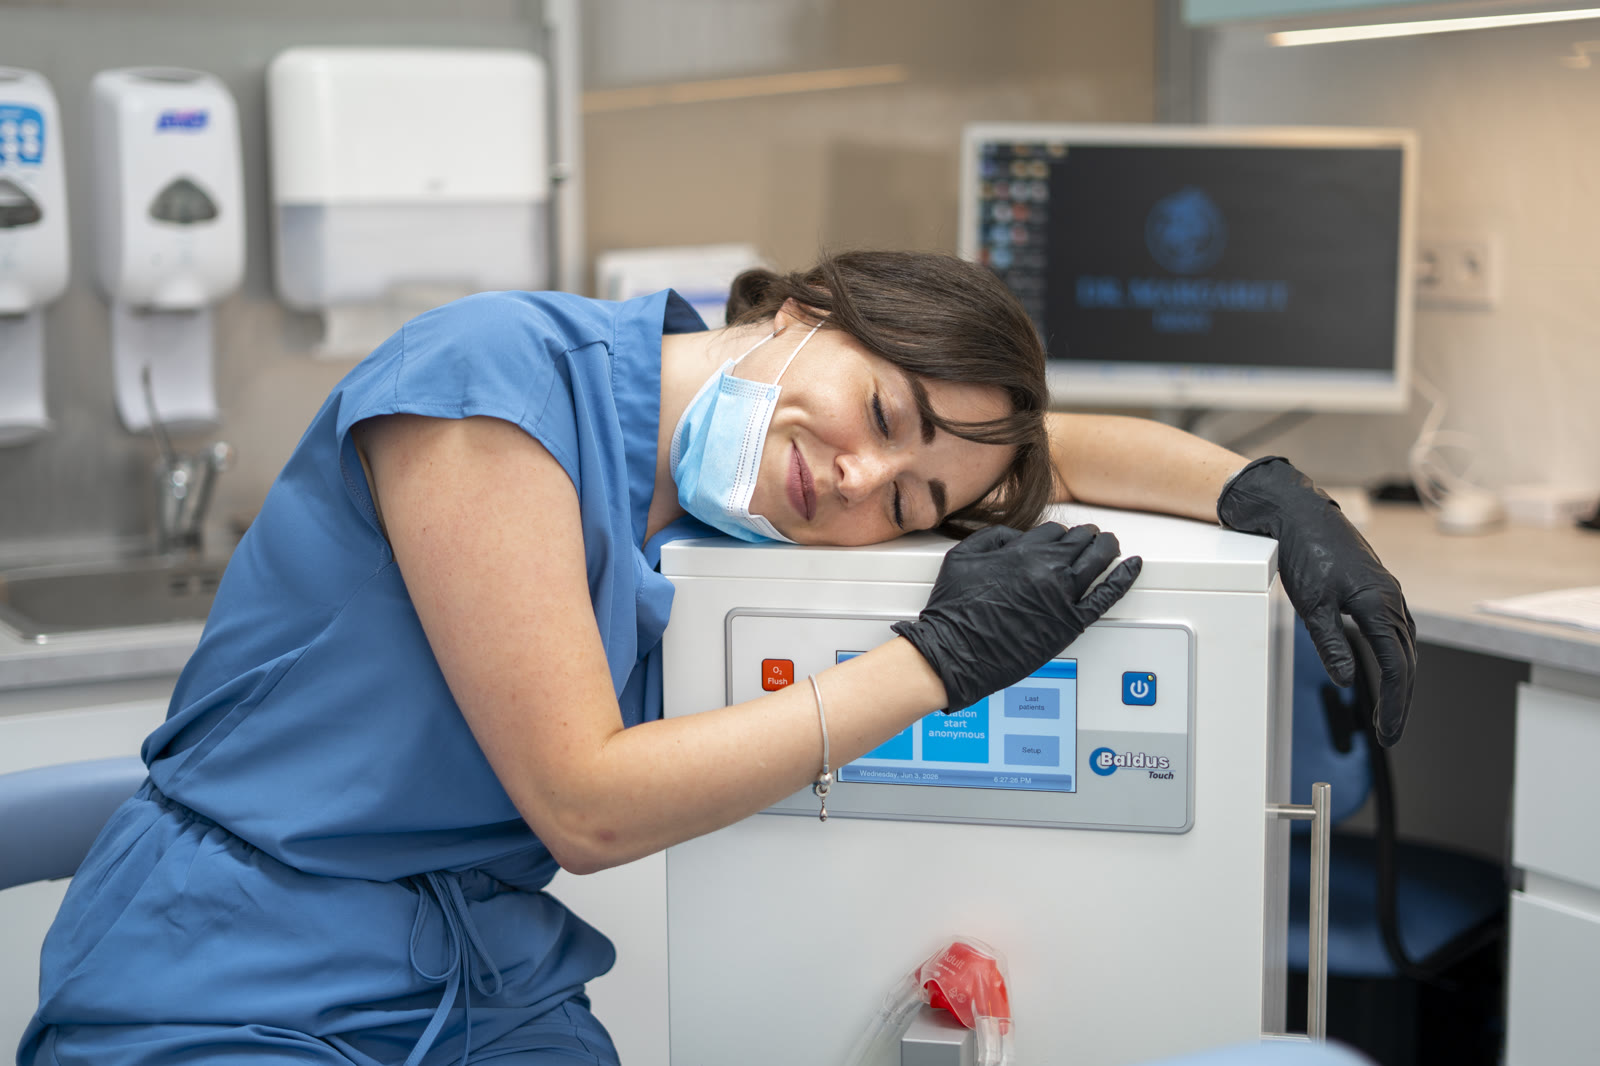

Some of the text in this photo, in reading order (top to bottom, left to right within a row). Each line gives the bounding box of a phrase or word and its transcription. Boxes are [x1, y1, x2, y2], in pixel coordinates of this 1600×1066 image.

[767, 677, 788, 685] Flush
[1018, 704, 1045, 712] patients
[943, 719, 968, 728] start
[928, 729, 985, 740] anonymous
[1022, 746, 1041, 755] Setup
[1101, 751, 1170, 769] Baldus
[859, 769, 899, 779] Wednesday,
[1148, 770, 1174, 780] Touch
[1020, 776, 1032, 784] PM
[943, 951, 965, 970] Adult
